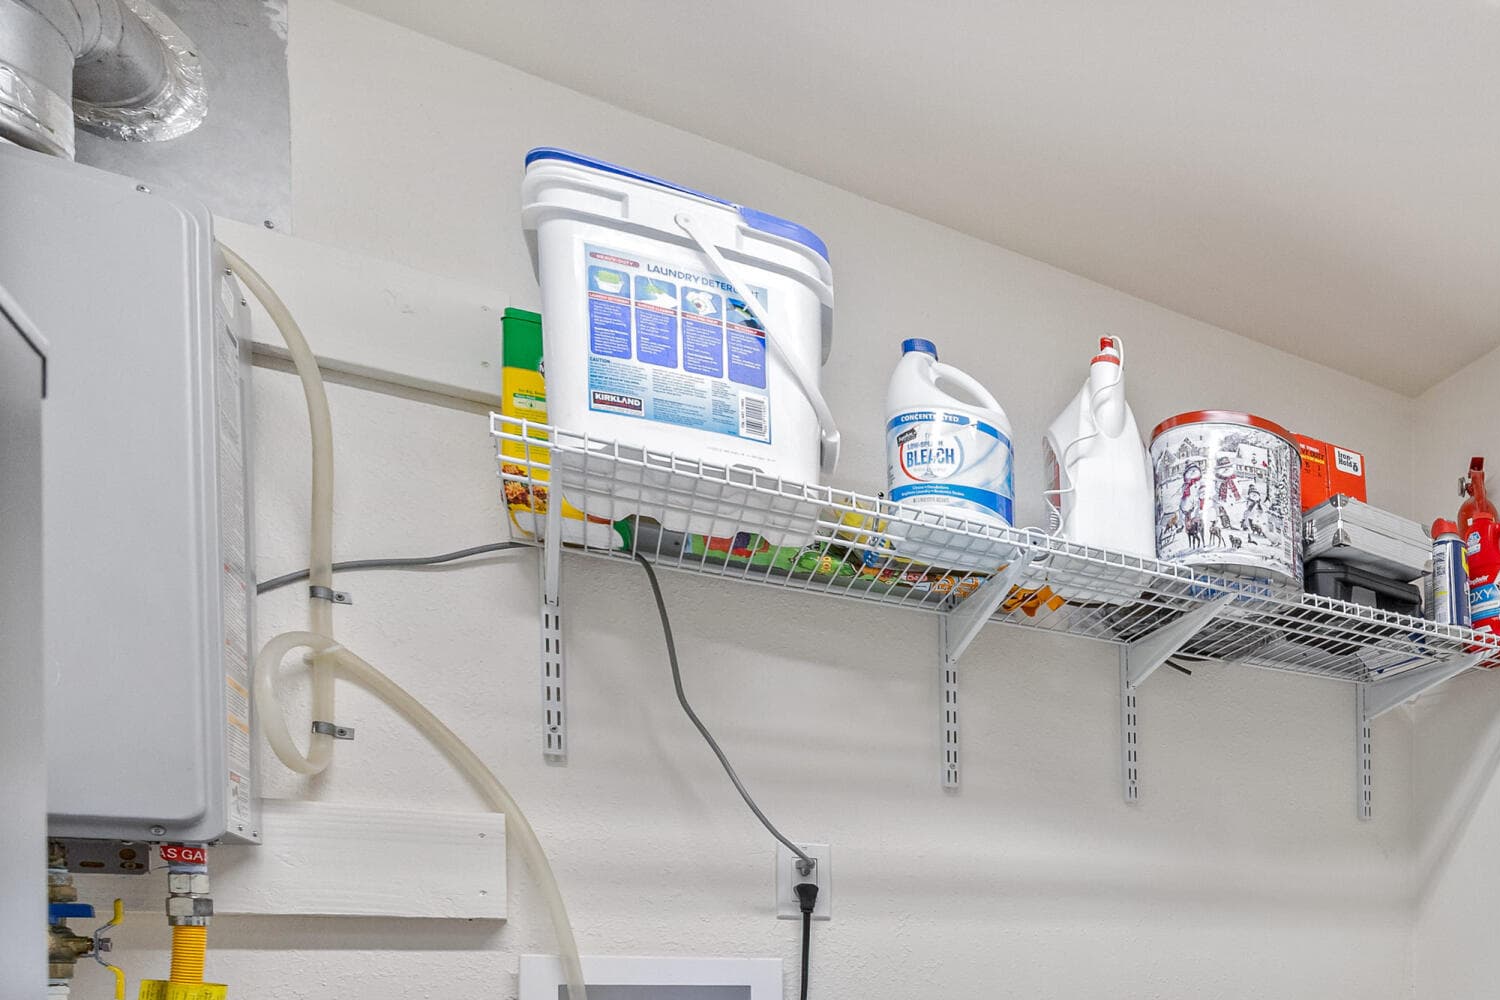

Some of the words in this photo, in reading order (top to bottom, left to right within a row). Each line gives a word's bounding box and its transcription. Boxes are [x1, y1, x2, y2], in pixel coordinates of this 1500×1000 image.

[647, 263, 700, 284] LAUNDRY
[594, 392, 642, 407] KIRKLAND
[906, 448, 955, 468] BLEACH
[181, 849, 208, 861] GA
